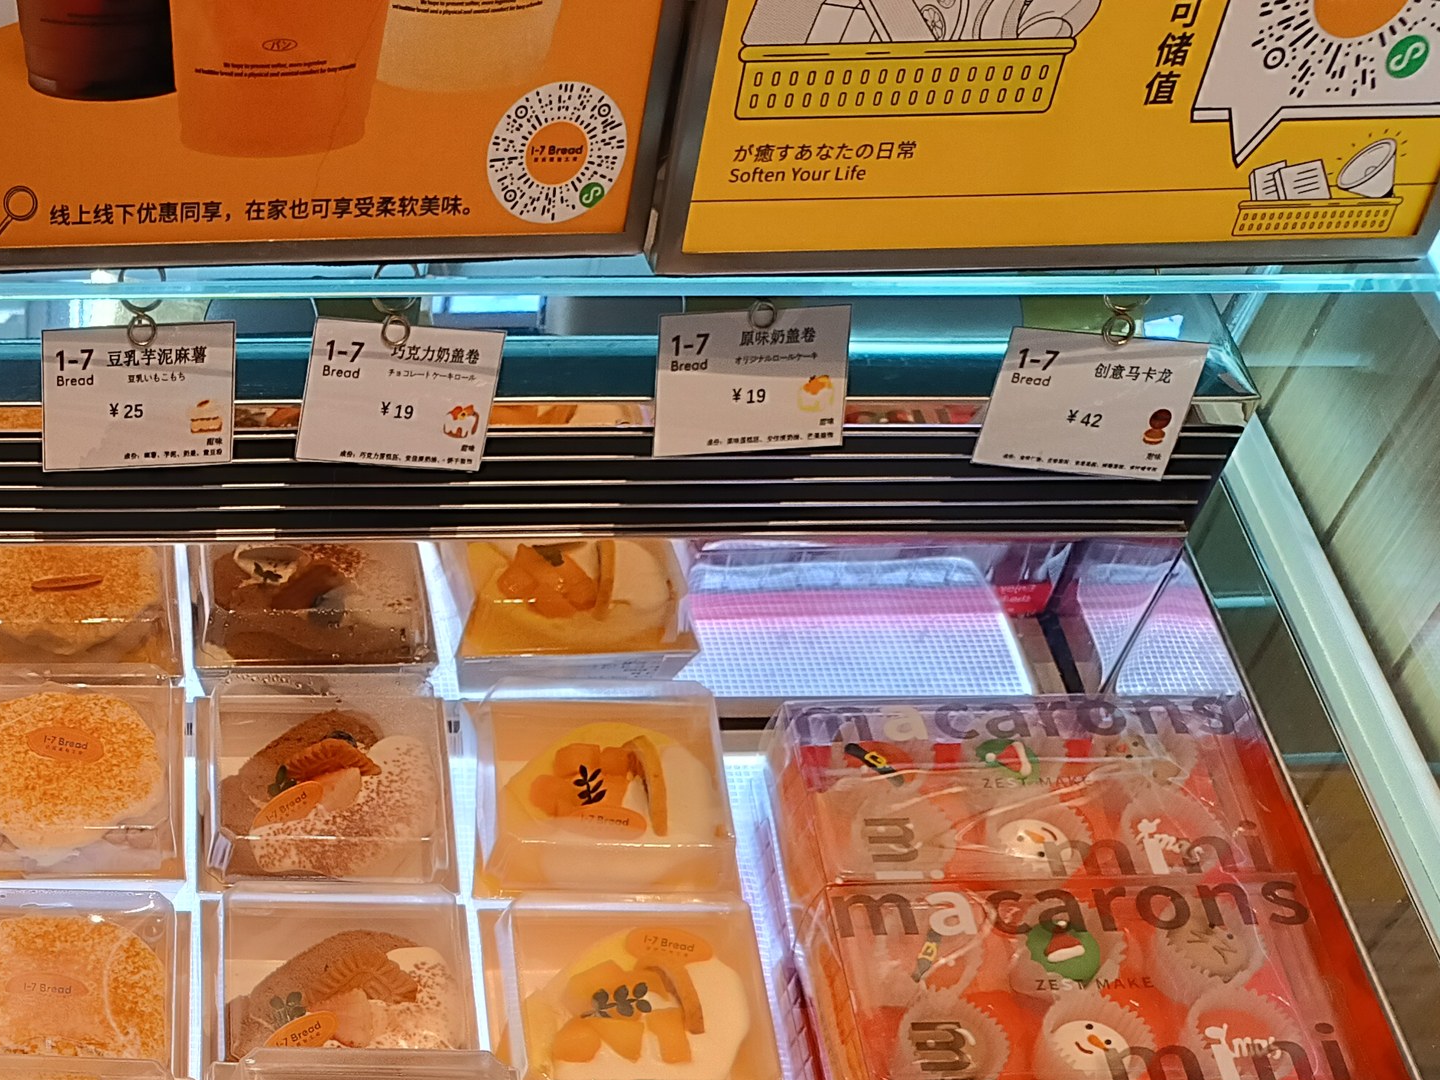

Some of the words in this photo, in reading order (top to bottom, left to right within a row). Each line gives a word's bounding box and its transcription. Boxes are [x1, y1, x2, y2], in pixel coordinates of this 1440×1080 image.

[733, 140, 917, 163] が癒すあなたの日常
[728, 167, 786, 183] Soften
[792, 167, 830, 181] Your
[834, 164, 866, 180] Life
[671, 333, 710, 356] 1-7
[740, 327, 816, 347] 原味奶盖卷
[55, 349, 94, 371] 1-7
[107, 346, 207, 367] 豆乳芋泥麻薯
[326, 340, 365, 363] 1-7
[391, 345, 480, 364] 巧克力奶盖卷
[1018, 348, 1060, 371] 1-7
[322, 365, 360, 379] Bread
[671, 359, 708, 372] Bread
[1095, 364, 1173, 384] 创意马卡龙
[56, 375, 94, 386] Bread
[1011, 373, 1051, 387] Bread
[58, 738, 88, 750] Bread
[835, 880, 1311, 938] macarons
[1035, 978, 1089, 991] ZEST
[1095, 976, 1154, 990] MAKE
